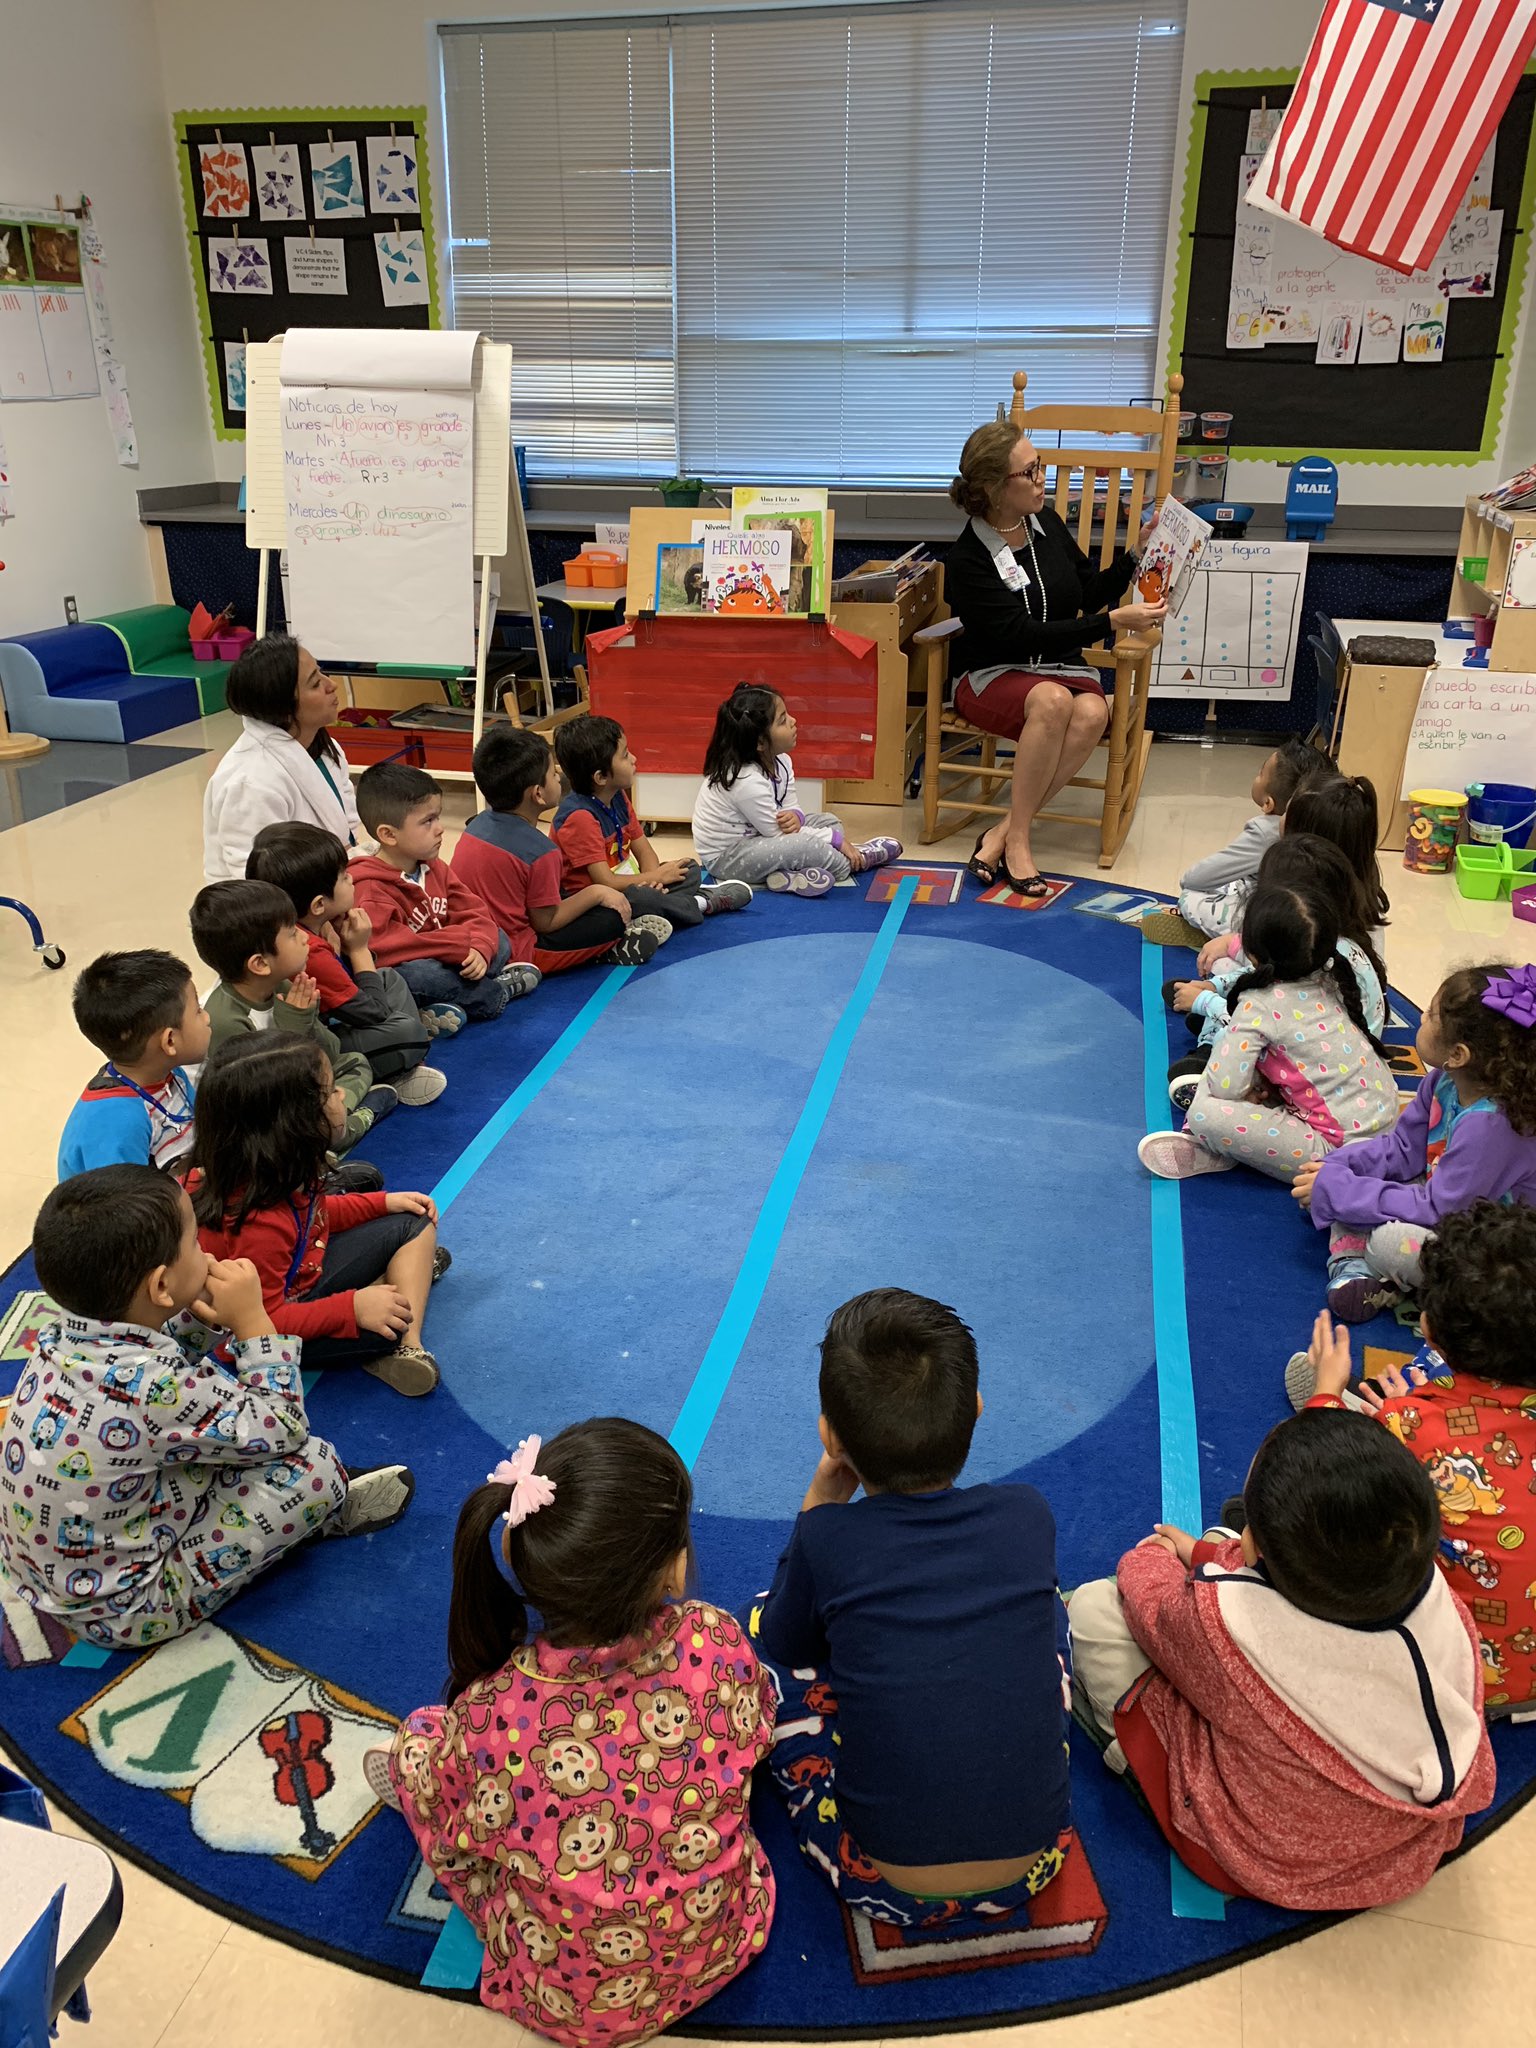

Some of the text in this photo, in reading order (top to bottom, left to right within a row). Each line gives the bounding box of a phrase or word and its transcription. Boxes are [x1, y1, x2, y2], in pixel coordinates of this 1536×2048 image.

[1278, 266, 1326, 282] protegen
[1376, 276, 1390, 285] de
[1276, 280, 1336, 297] a la gente
[288, 397, 398, 416] Noticias de hoy
[398, 422, 412, 432] es
[286, 450, 324, 466] Martes
[392, 458, 406, 467] es
[1295, 484, 1332, 494] MAIL
[295, 526, 310, 536] es
[606, 526, 616, 538] Yo
[712, 540, 780, 556] HERMOSO
[1207, 542, 1270, 560] tu figura
[1435, 677, 1476, 692] puedo
[1420, 696, 1530, 712] una carta a un
[1415, 718, 1452, 732] amigo
[1458, 729, 1468, 738] le
[1471, 732, 1492, 740] van
